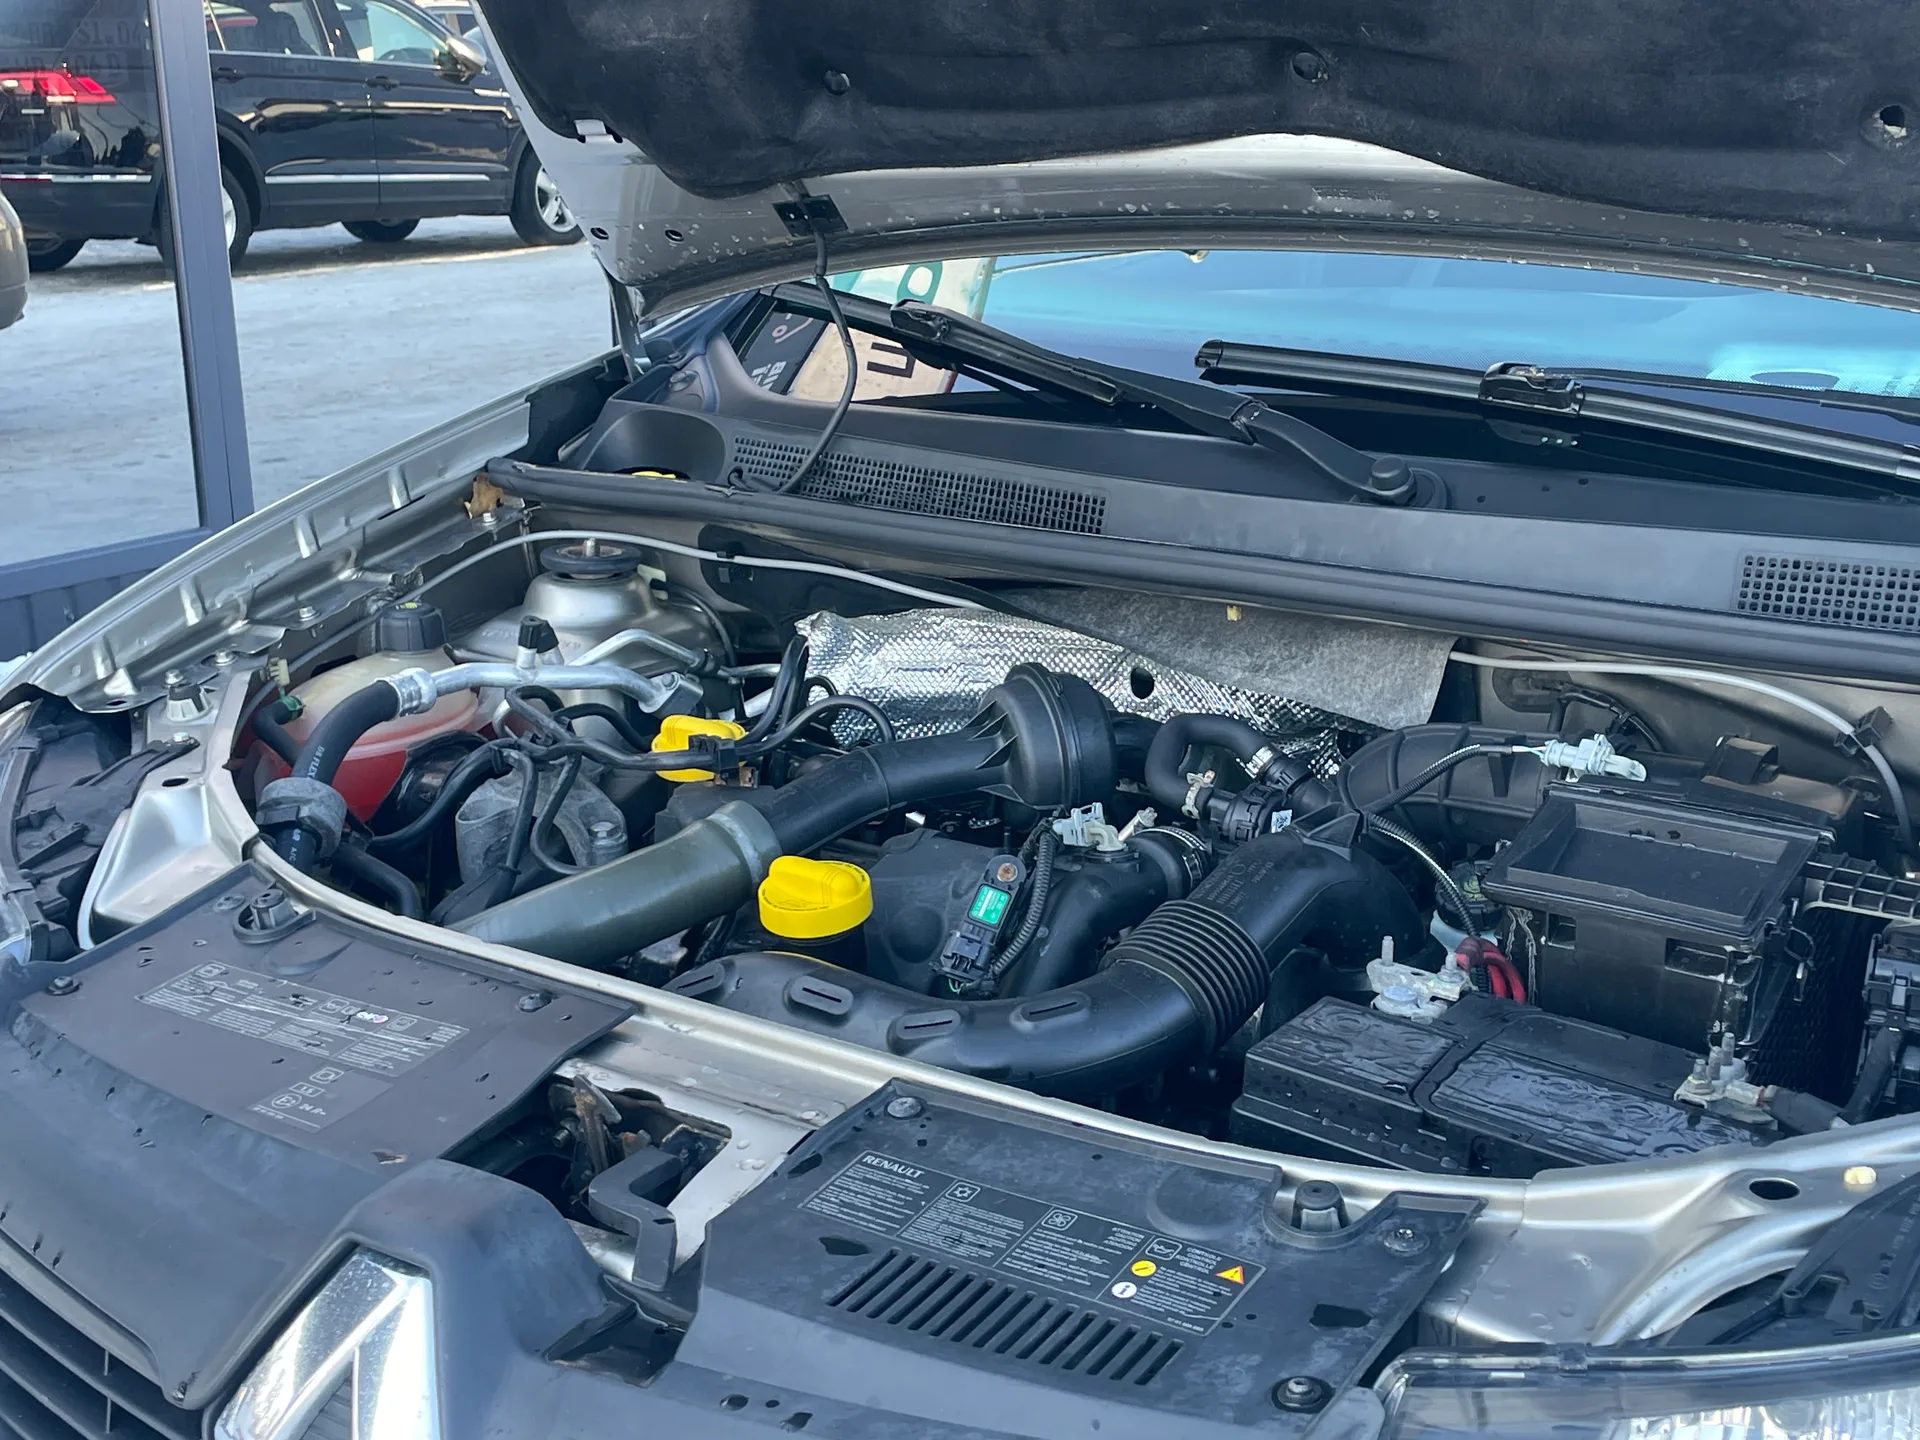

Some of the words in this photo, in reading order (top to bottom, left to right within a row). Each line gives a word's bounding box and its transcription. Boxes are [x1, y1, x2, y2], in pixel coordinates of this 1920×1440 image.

[862, 1155, 925, 1178] RENAULT
[1175, 1254, 1215, 1270] KONTROLLE
[1187, 1253, 1217, 1266] CONTROL
[1179, 1261, 1210, 1274] CONTROL
